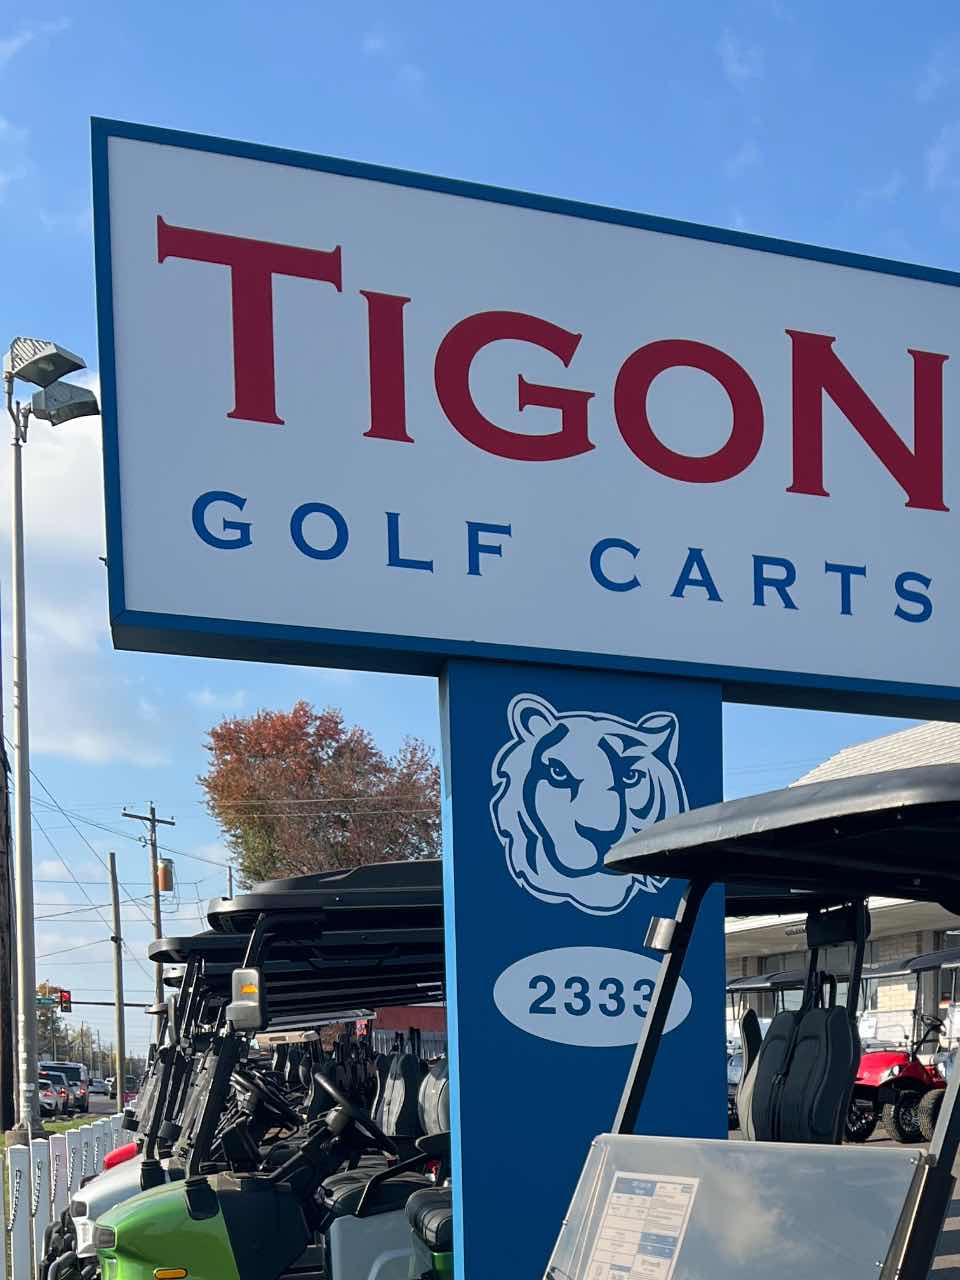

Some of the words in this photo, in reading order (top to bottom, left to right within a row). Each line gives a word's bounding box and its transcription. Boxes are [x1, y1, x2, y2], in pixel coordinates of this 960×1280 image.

[157, 214, 950, 512] TIGON
[190, 490, 512, 577] GOLF
[589, 537, 934, 624] CARTS
